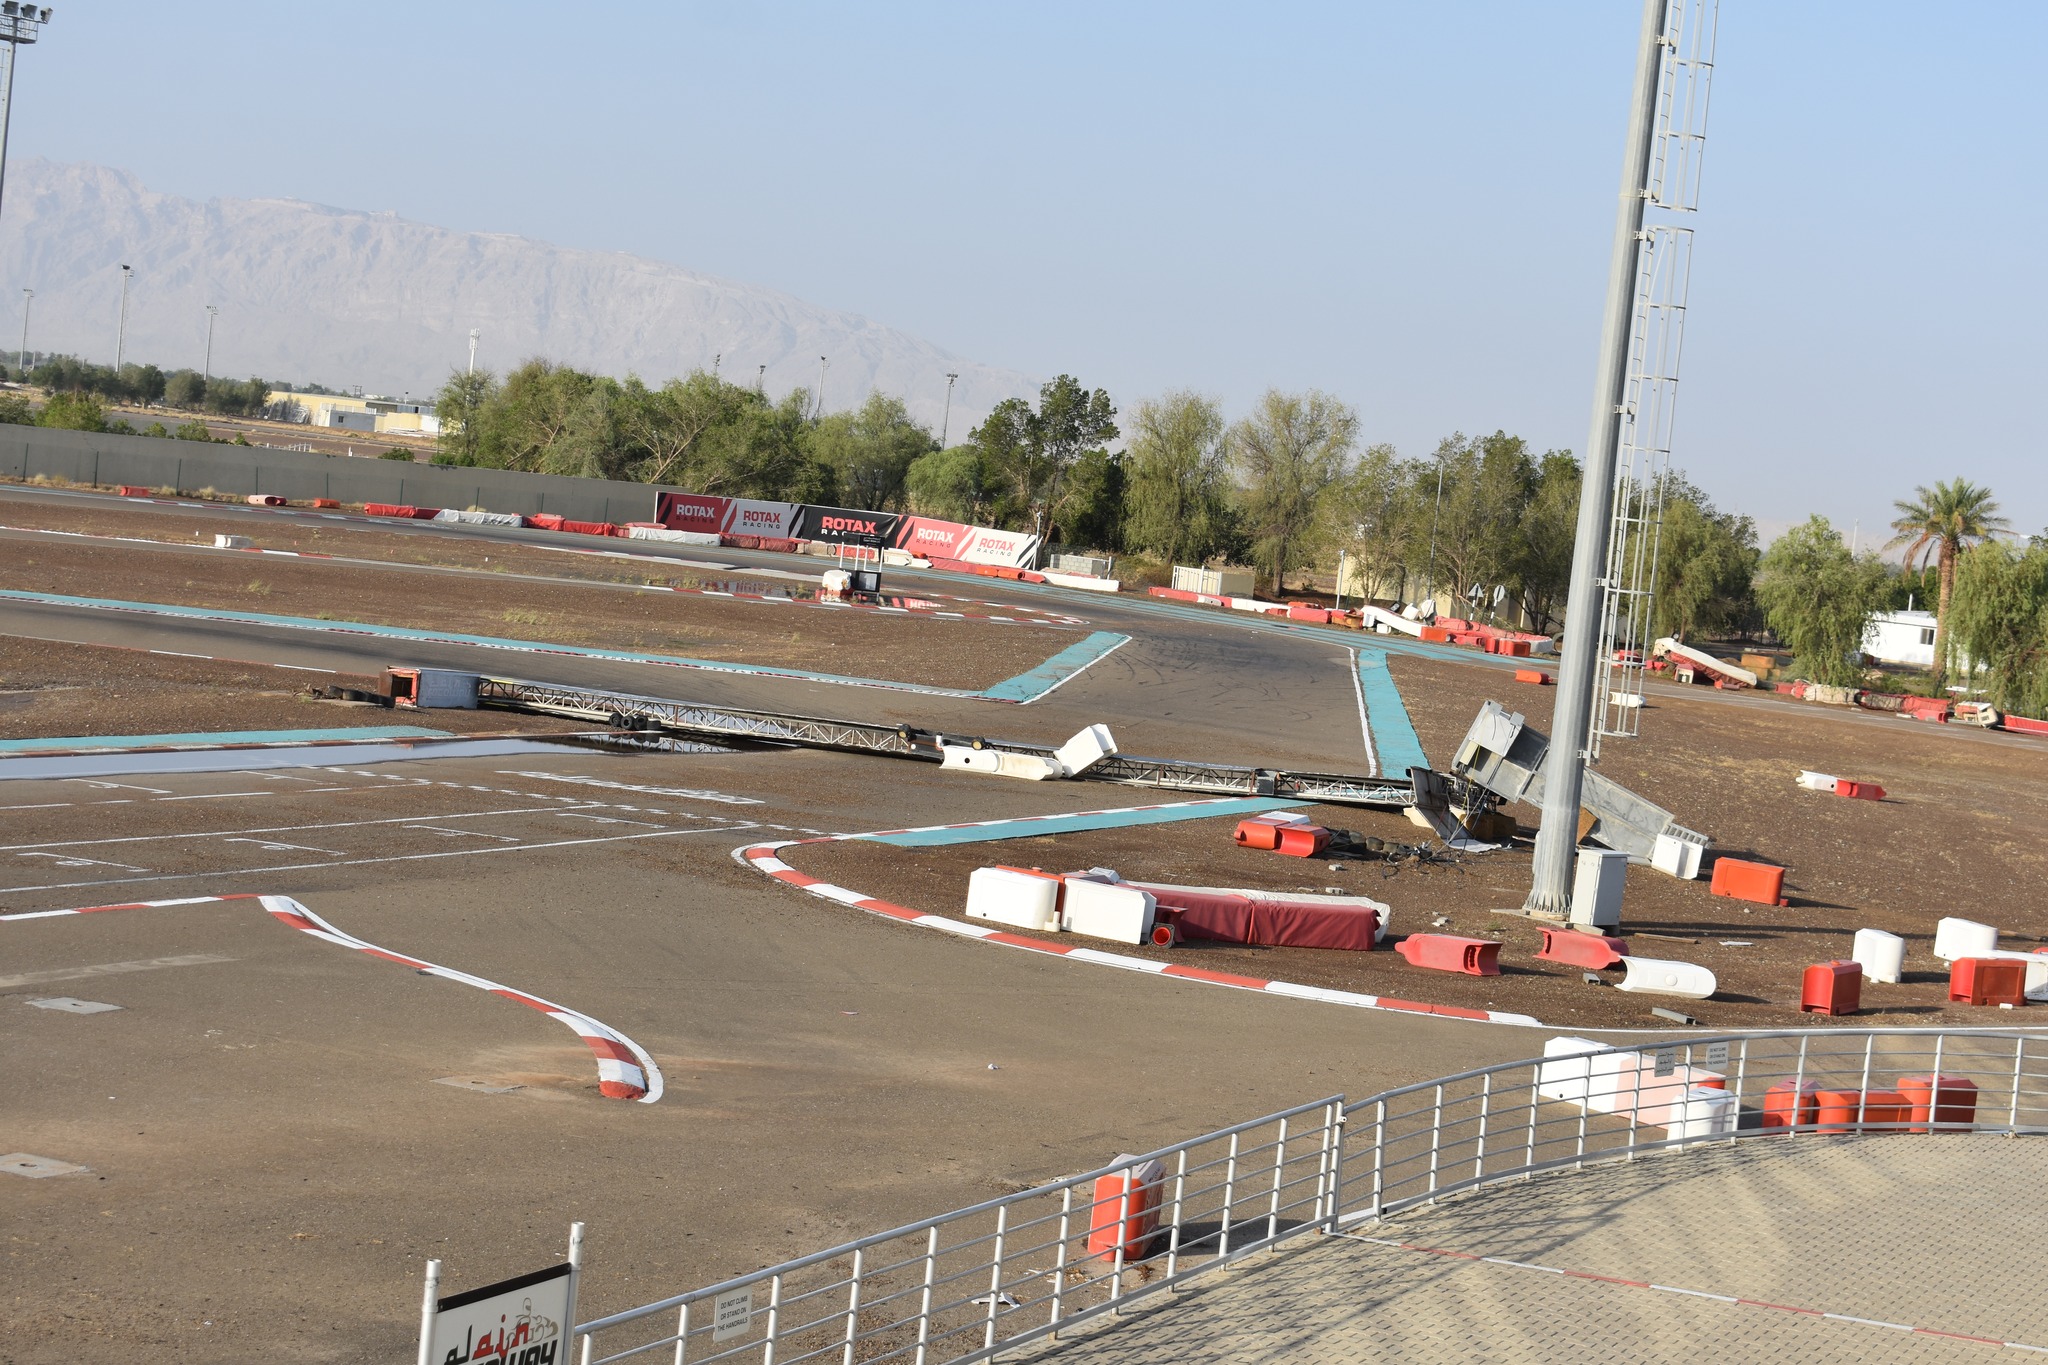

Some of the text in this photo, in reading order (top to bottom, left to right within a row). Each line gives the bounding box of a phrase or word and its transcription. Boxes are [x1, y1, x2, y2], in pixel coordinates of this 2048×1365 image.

[676, 504, 715, 518] ROTAX
[743, 510, 781, 523] ROTAX
[676, 516, 715, 524] RACING
[742, 521, 781, 529] RACING
[821, 516, 877, 534] ROTAX
[917, 527, 955, 543] ROTAX
[916, 538, 951, 549] RACING
[978, 537, 1016, 551] ROTAX
[976, 548, 1012, 557] RACING
[736, 1295, 748, 1304] CLIMB
[727, 1308, 740, 1318] STAND
[725, 1317, 748, 1329] HANDRAILS
